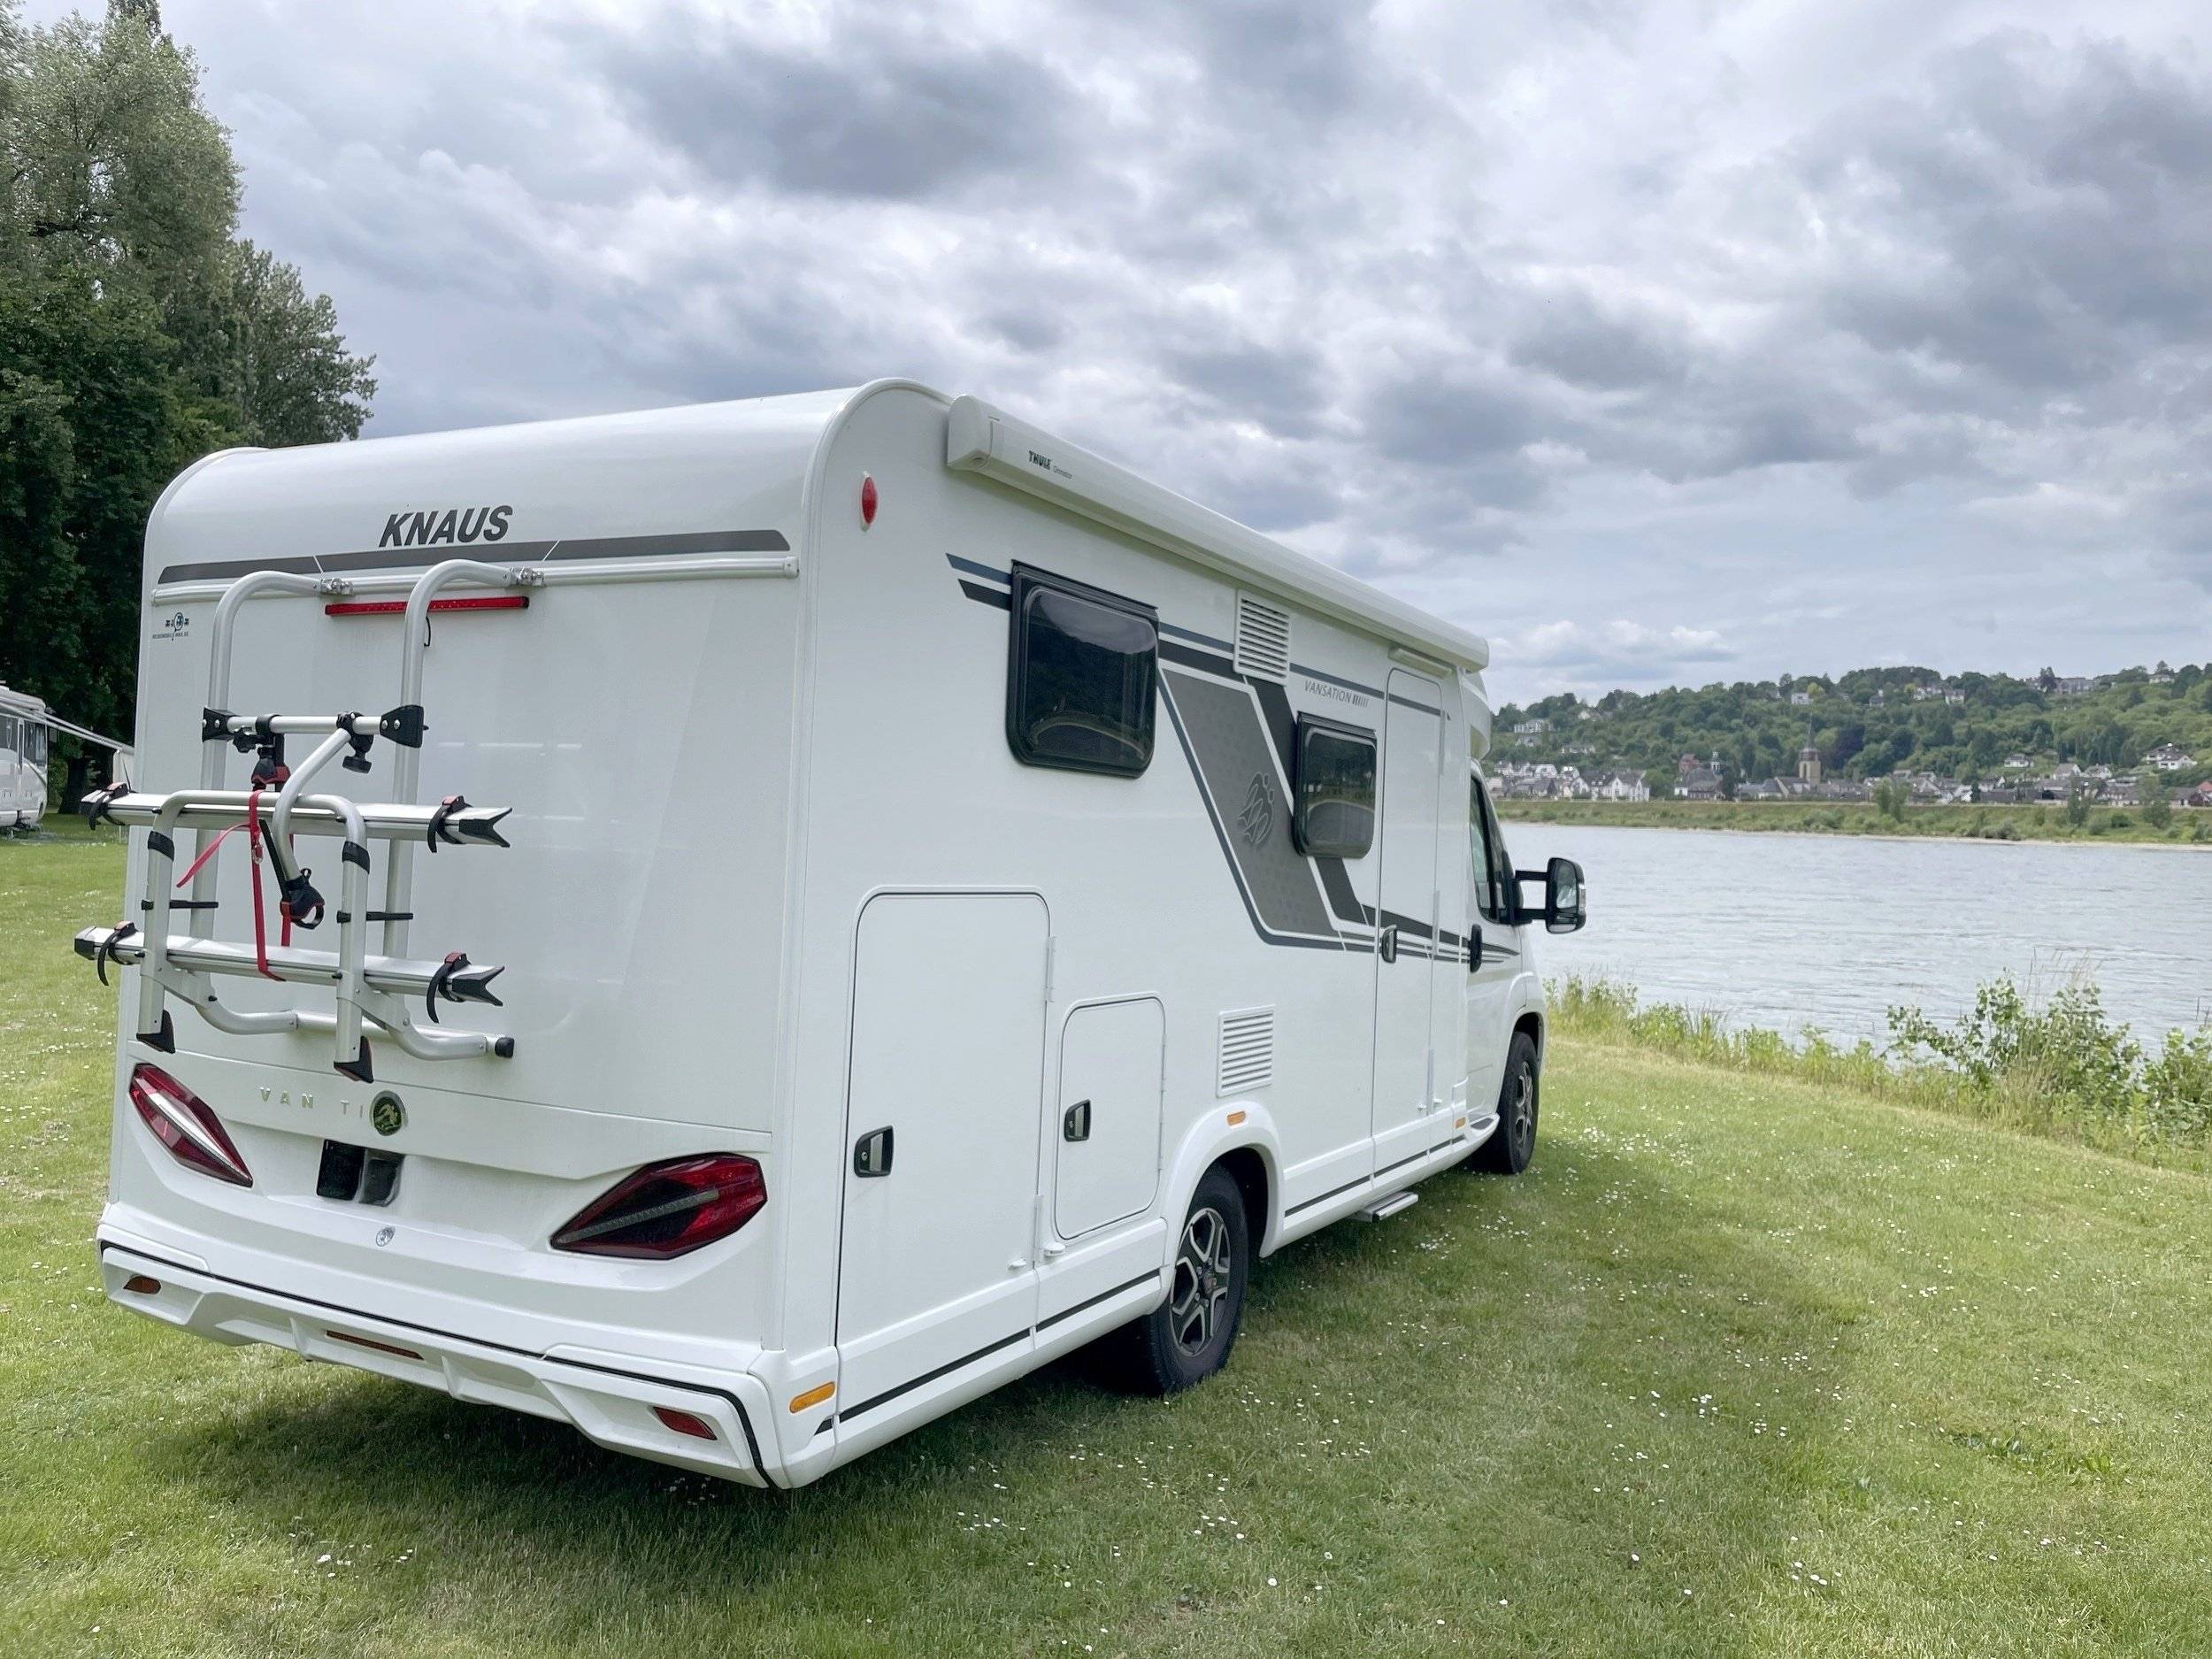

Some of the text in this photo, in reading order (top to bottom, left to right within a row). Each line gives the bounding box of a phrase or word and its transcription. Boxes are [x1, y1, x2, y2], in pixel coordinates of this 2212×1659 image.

[1028, 449, 1052, 471] THULE
[379, 505, 513, 548] KNAUS
[1303, 680, 1352, 704] VANSATION
[259, 1086, 364, 1118] VAN TI
